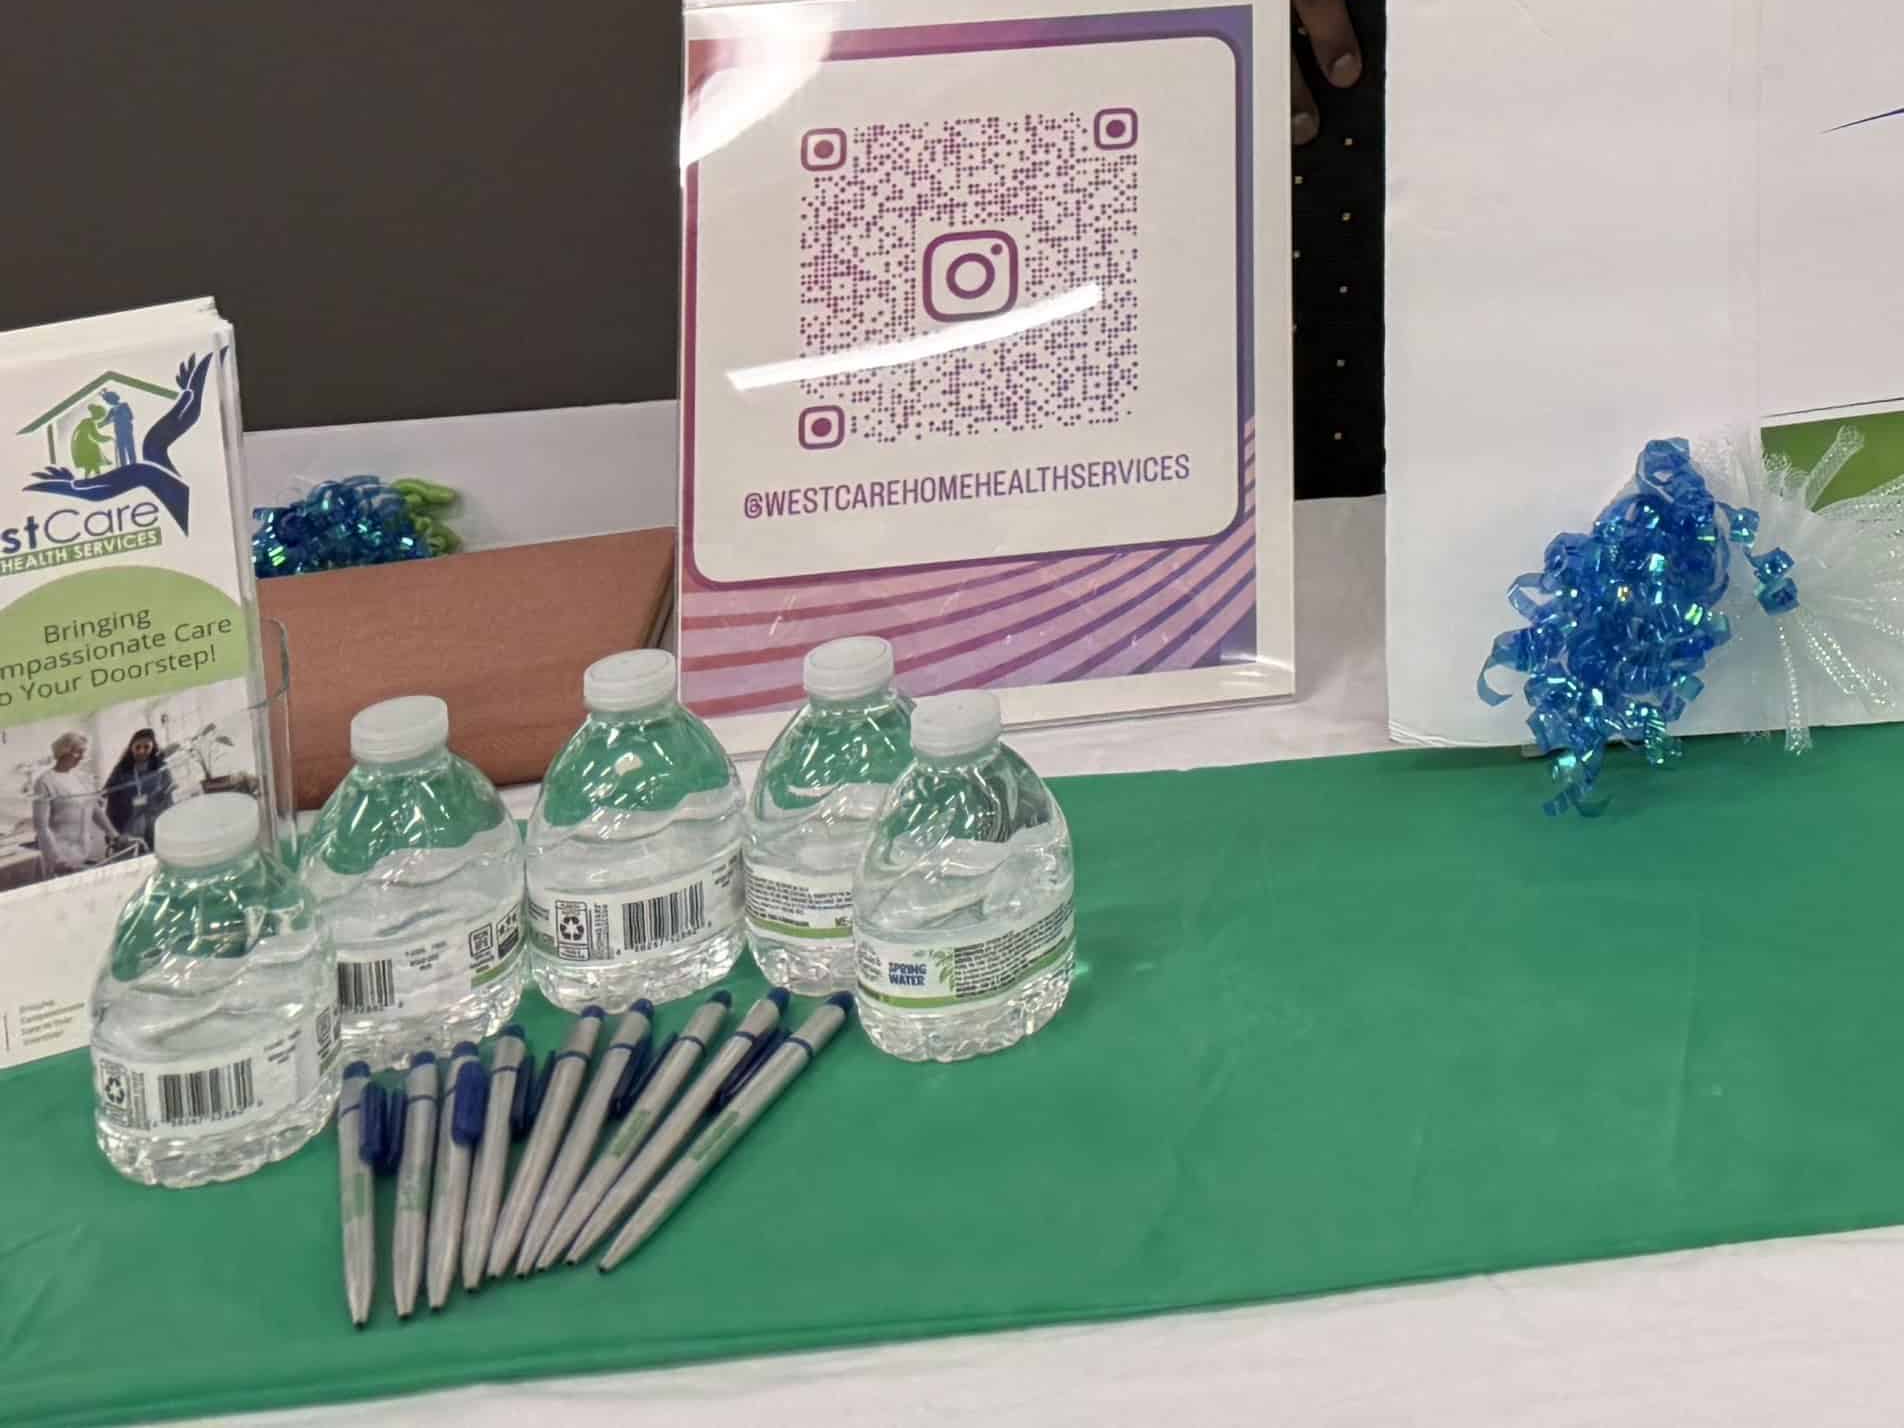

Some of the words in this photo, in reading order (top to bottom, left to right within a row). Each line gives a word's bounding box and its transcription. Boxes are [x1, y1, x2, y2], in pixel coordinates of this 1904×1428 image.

[743, 453, 1190, 518] @WESTCAREHOMEHEALTHSERVICES
[0, 501, 159, 554] stCare
[1, 546, 67, 573] HEALTH
[72, 530, 158, 559] SERVICES
[0, 631, 166, 680] mpassionate
[175, 618, 232, 642] Care
[44, 608, 151, 644] Bringing
[20, 675, 87, 701] Your
[91, 644, 216, 687] Doorstep!
[888, 962, 926, 975] SPRING
[889, 974, 925, 986] WATER
